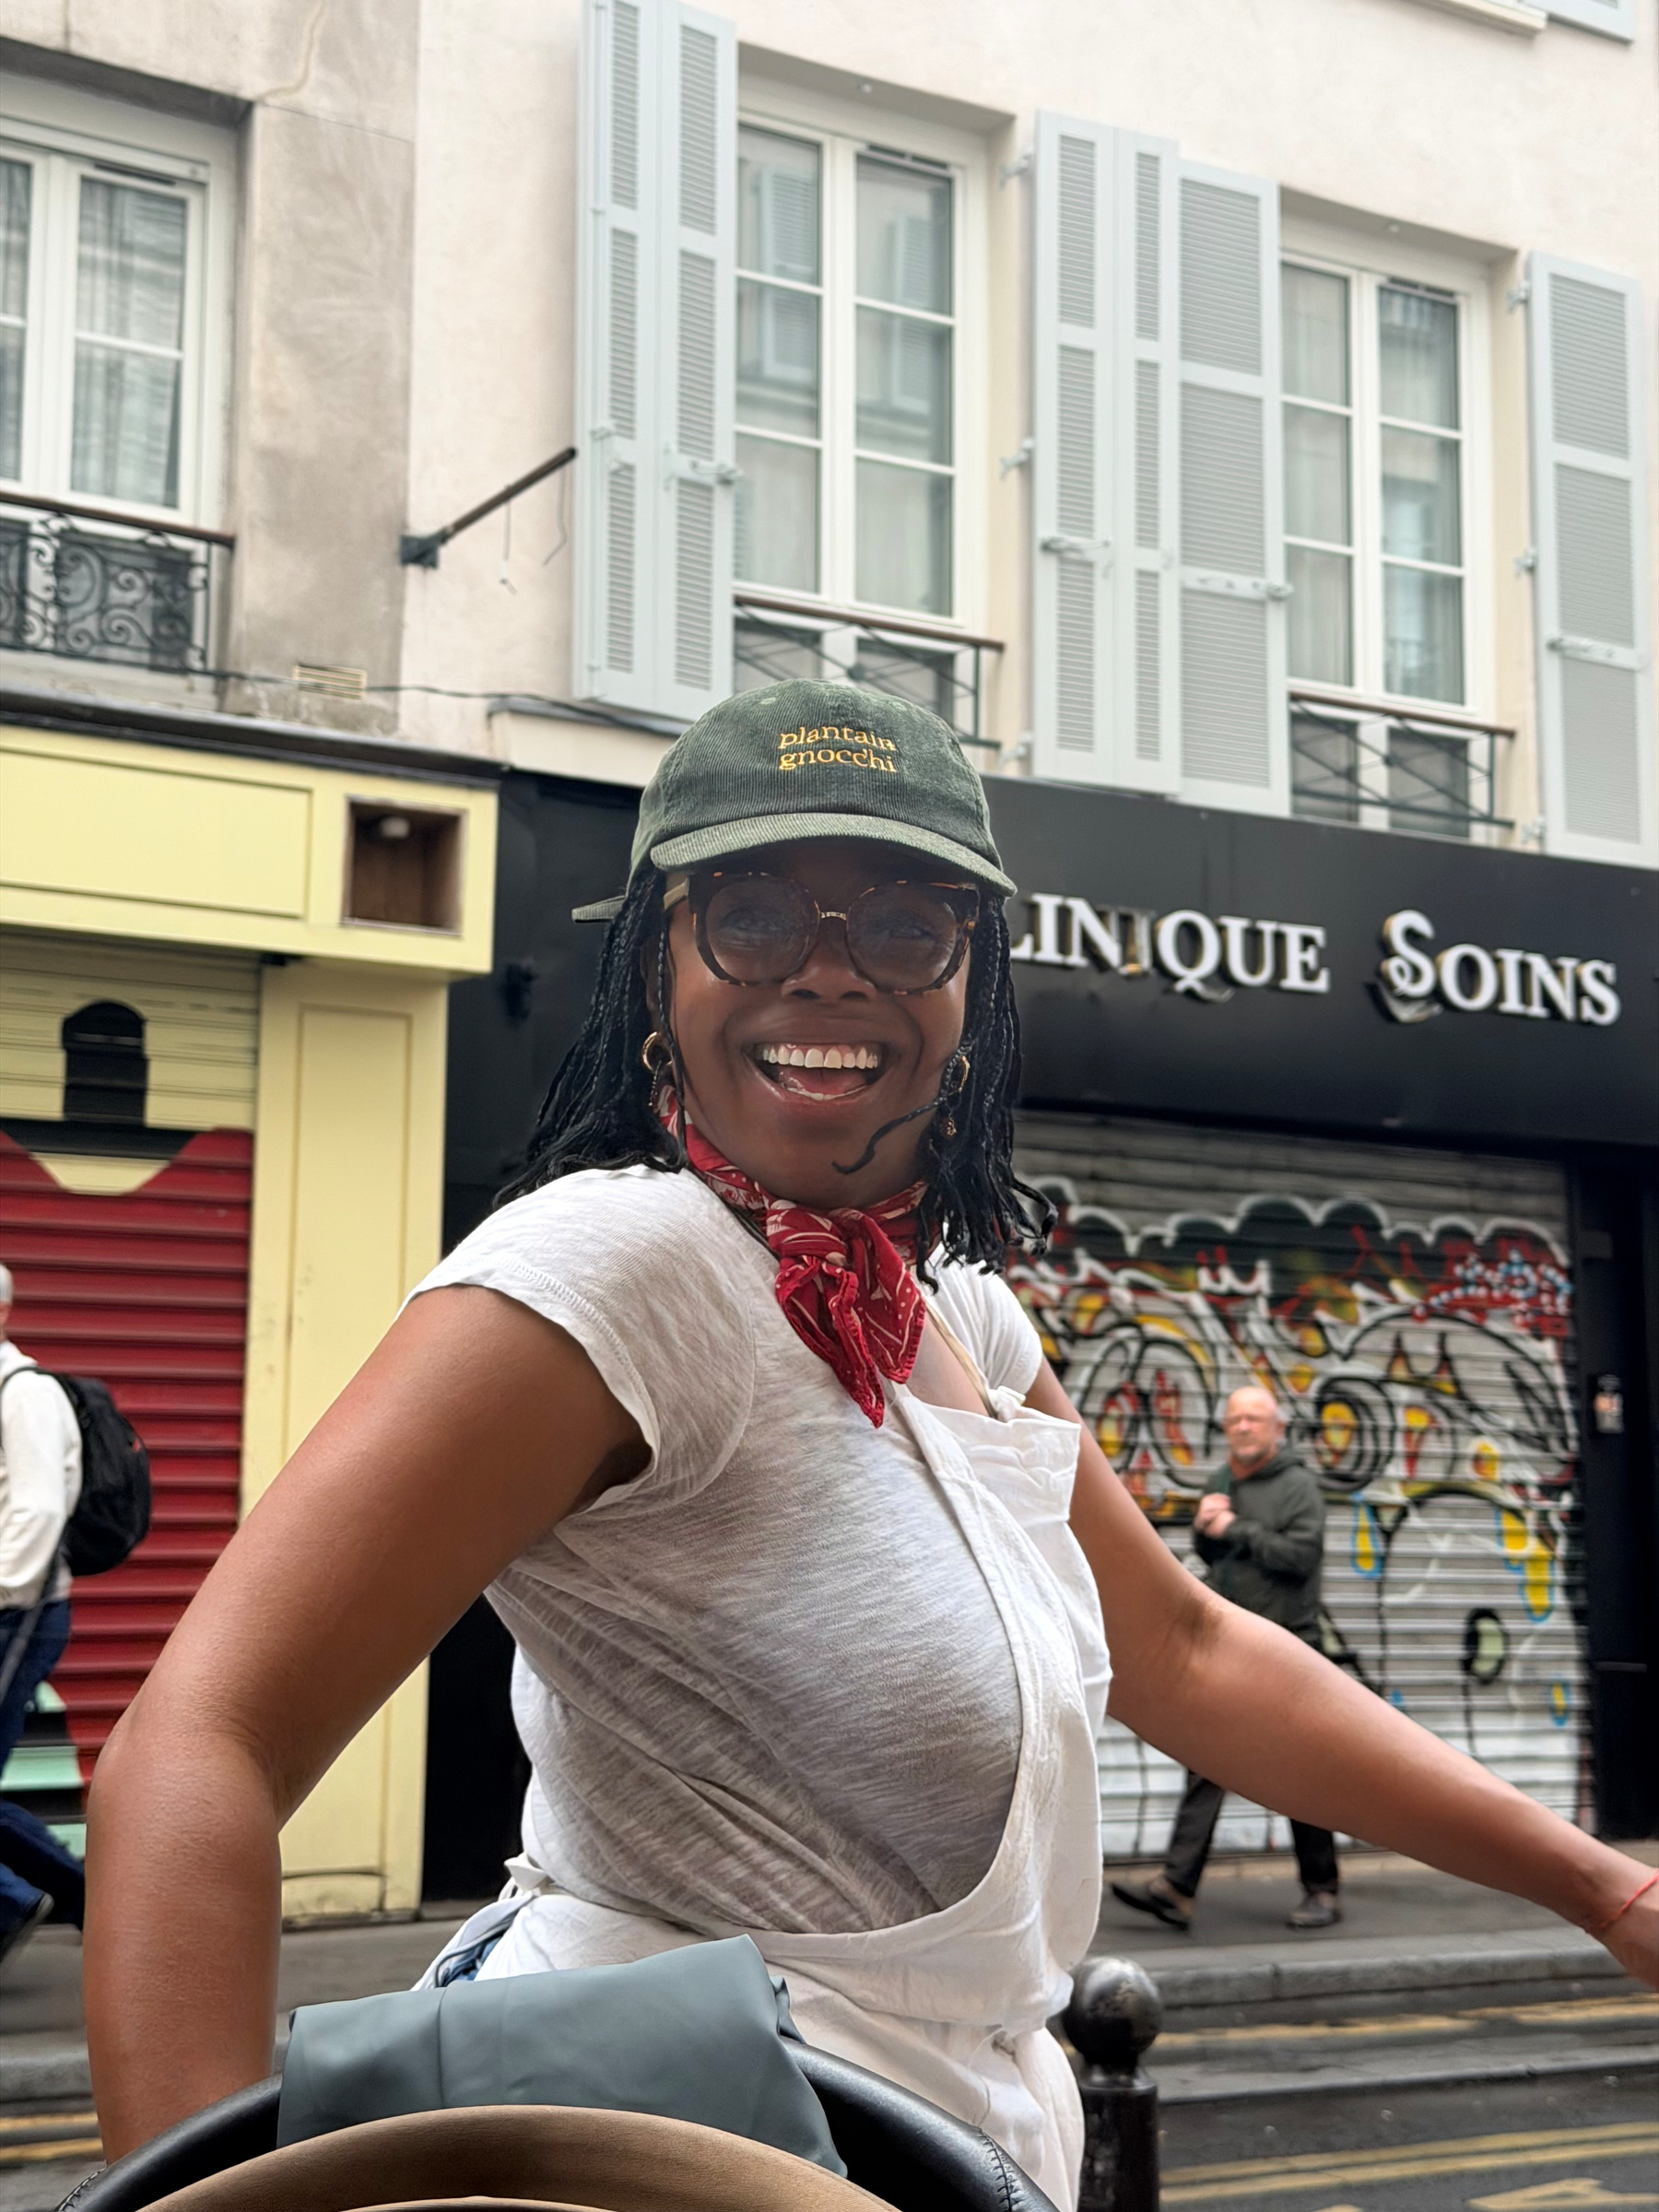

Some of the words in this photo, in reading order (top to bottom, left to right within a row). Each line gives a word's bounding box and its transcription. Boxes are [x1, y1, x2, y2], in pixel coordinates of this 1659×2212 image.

[778, 725, 897, 751] plantain
[779, 748, 897, 772] gnocchi
[1382, 909, 1620, 1026] SOINS
